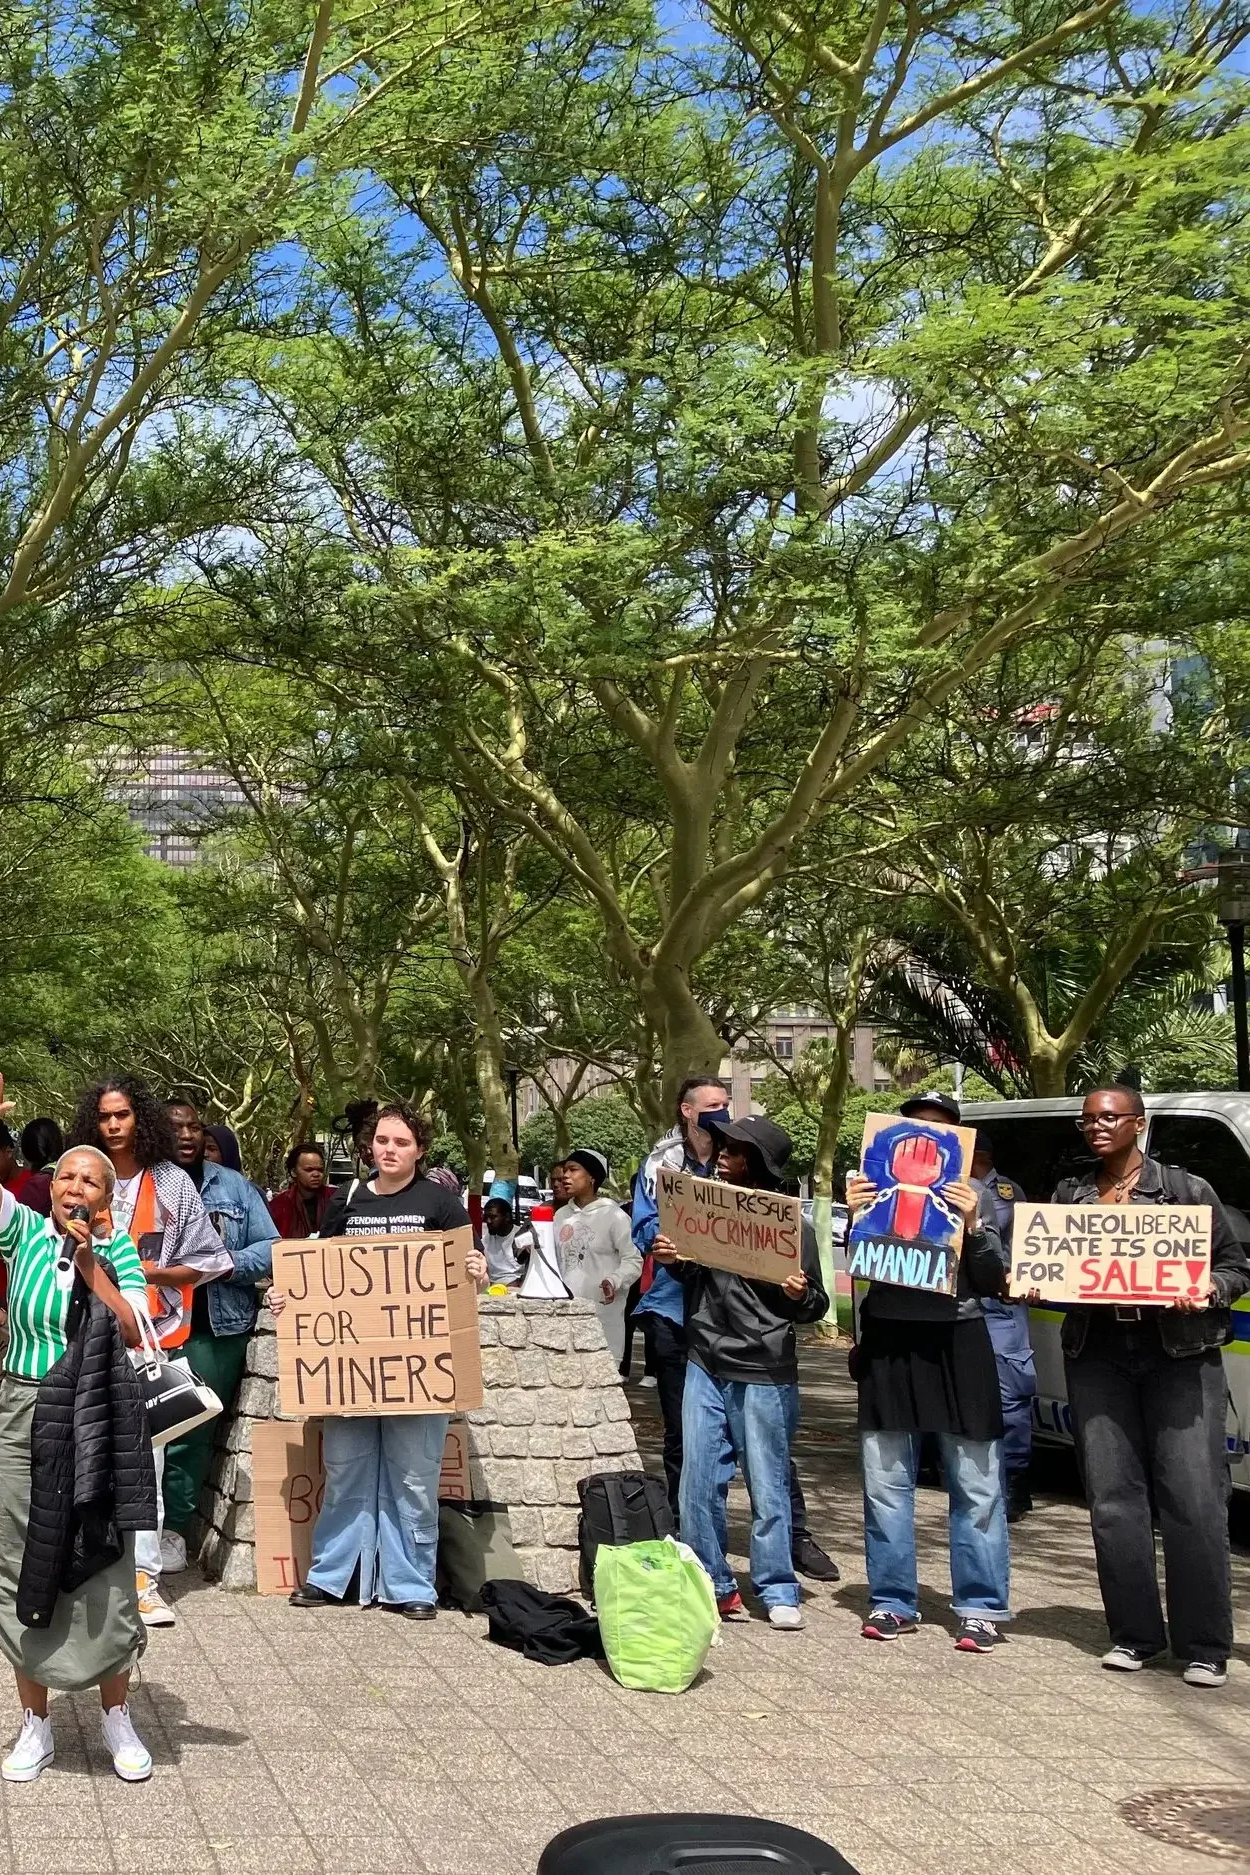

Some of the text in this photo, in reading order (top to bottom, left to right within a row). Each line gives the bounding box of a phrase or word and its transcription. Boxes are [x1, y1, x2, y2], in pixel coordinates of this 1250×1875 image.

[661, 1174, 684, 1196] WE
[693, 1184, 730, 1209] WILL
[388, 1215, 426, 1225] WOMEN
[390, 1225, 425, 1234] RIGHTS
[673, 1203, 710, 1235] YOU
[1027, 1210, 1208, 1235] A NEOLIBERAL
[1024, 1235, 1207, 1258] STATE IS ONE
[282, 1240, 459, 1300] JUSTICE
[849, 1240, 948, 1291] AMANDLA
[1016, 1258, 1207, 1297] FOR SALE!
[294, 1304, 450, 1347] FOR THE
[295, 1352, 456, 1406] MINERS
